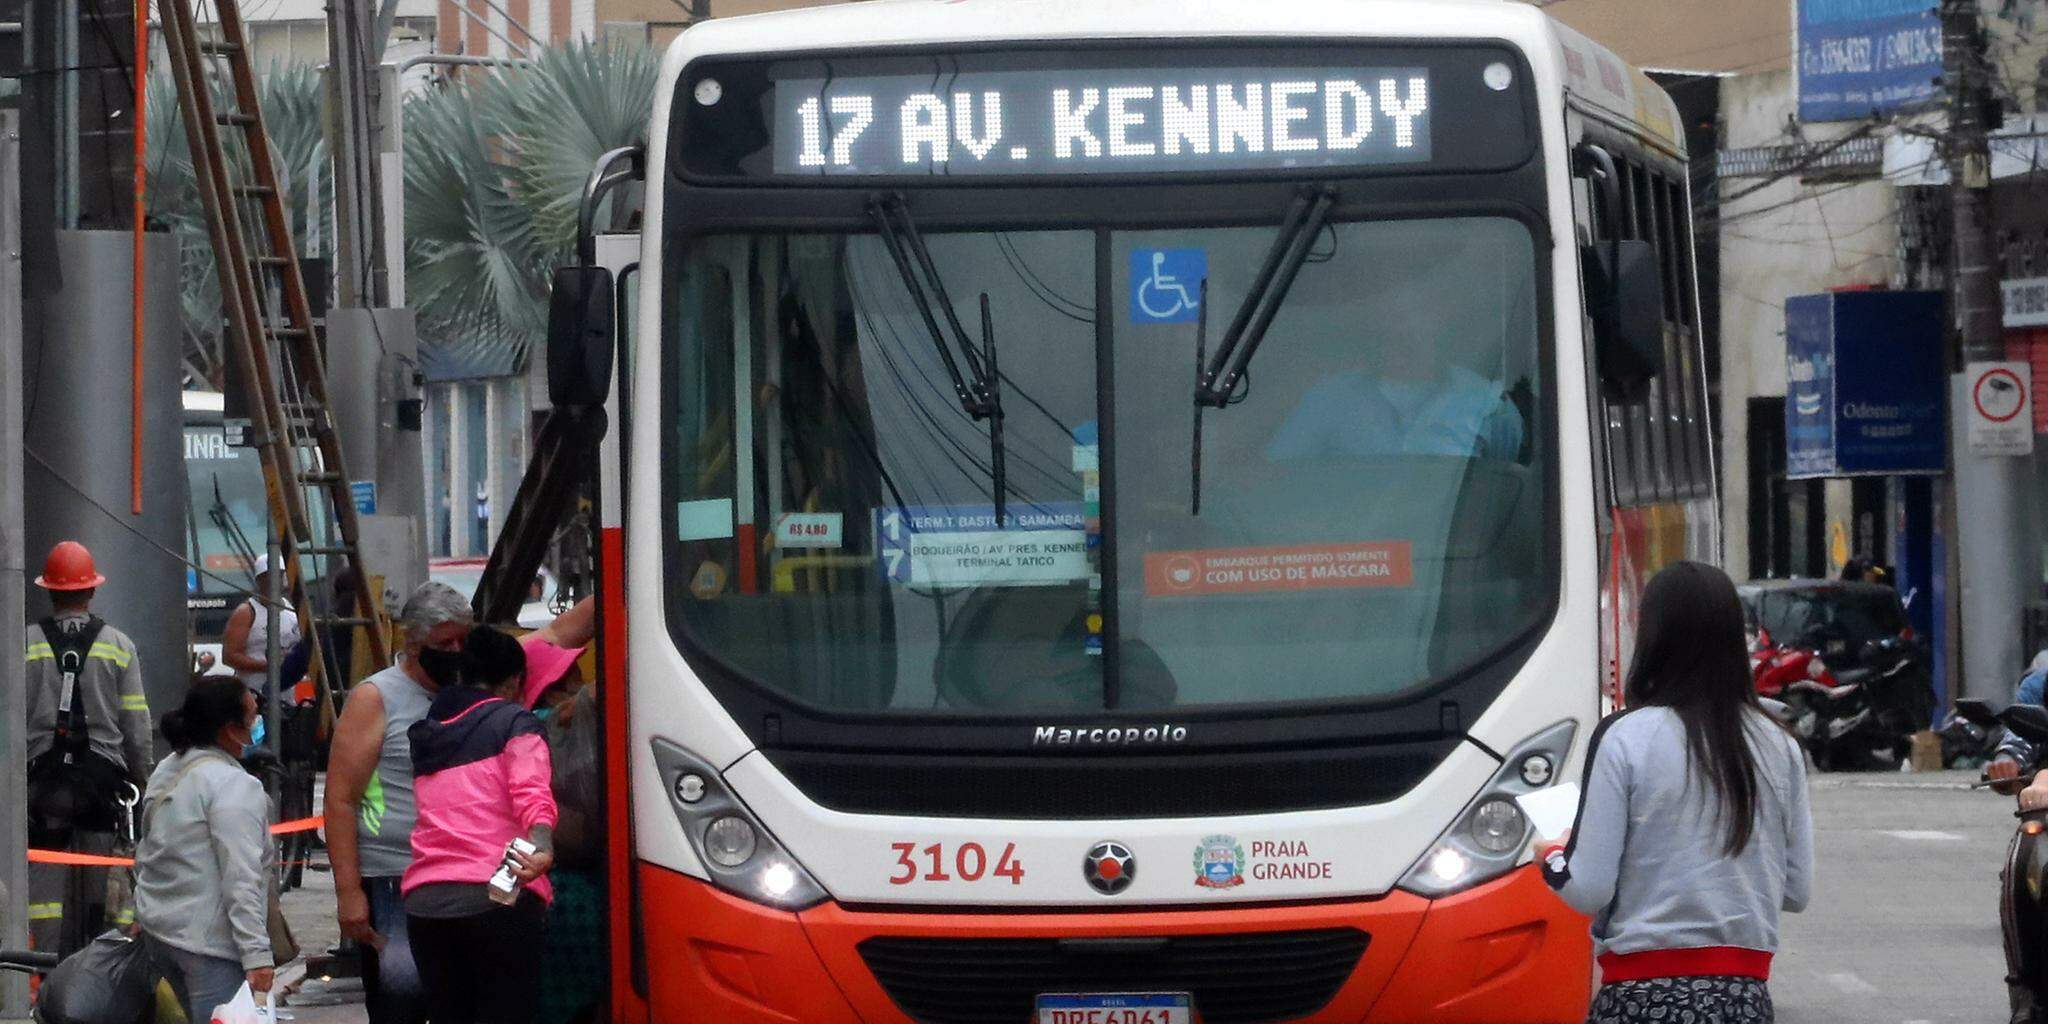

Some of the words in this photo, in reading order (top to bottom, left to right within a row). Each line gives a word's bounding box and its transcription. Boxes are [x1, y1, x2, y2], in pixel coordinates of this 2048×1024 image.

[798, 95, 873, 167] 17
[900, 91, 1028, 164] AV.
[1053, 77, 1427, 159] KENNEDY
[957, 558, 1012, 568] TERMINAL
[1206, 555, 1269, 567] EMBARQUE
[1272, 553, 1334, 565] PERMITIDO
[1337, 550, 1391, 562] SOMENTE
[1205, 570, 1244, 584] COM
[1249, 568, 1282, 582] USO
[1286, 567, 1308, 580] DE
[1312, 562, 1391, 579] MÁSCARA
[1032, 723, 1188, 746] Marcopolo
[1252, 840, 1309, 857] PRAIA
[888, 841, 1026, 886] 3104
[1252, 861, 1333, 880] GRANDE
